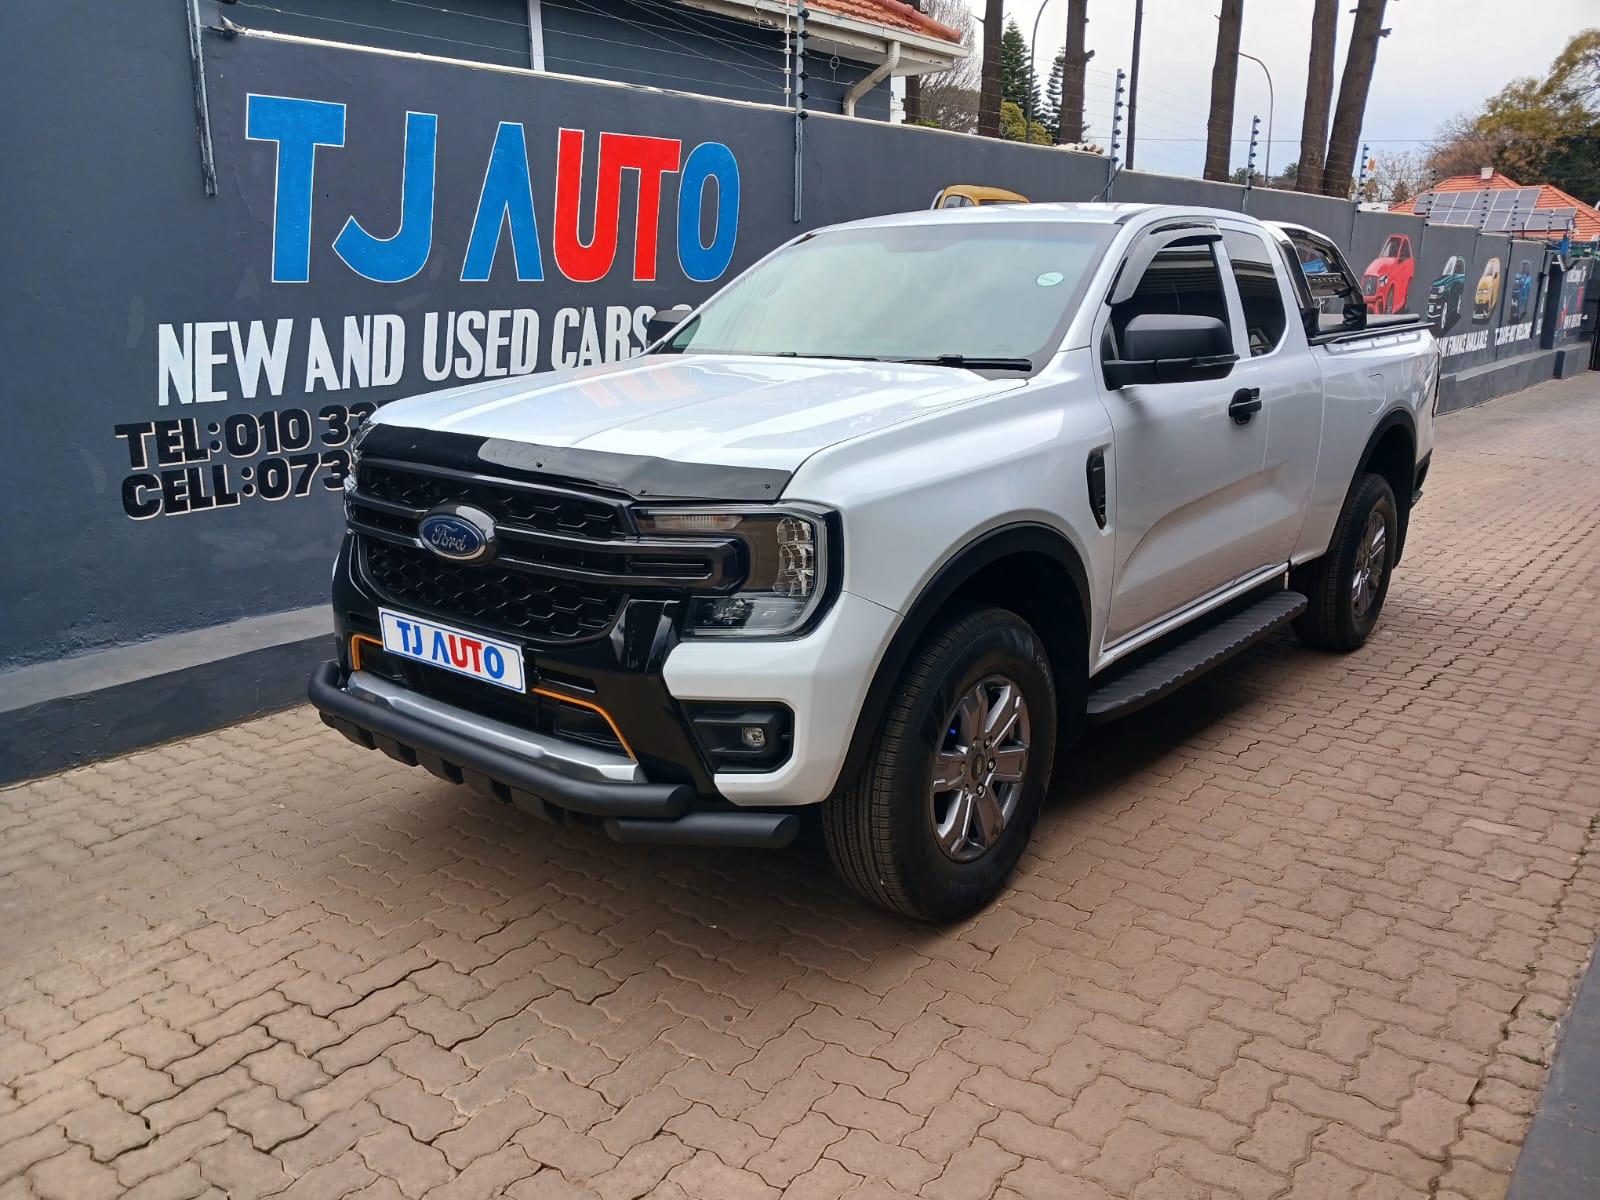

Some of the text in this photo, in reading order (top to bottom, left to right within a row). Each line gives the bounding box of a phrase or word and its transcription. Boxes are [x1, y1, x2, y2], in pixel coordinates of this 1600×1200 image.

[245, 92, 741, 283] TJ AUTO
[157, 305, 657, 406] NEW AND USED CARS
[114, 408, 313, 471] TEL:010
[431, 523, 468, 552] Ford
[396, 620, 505, 680] TJ AUTO
